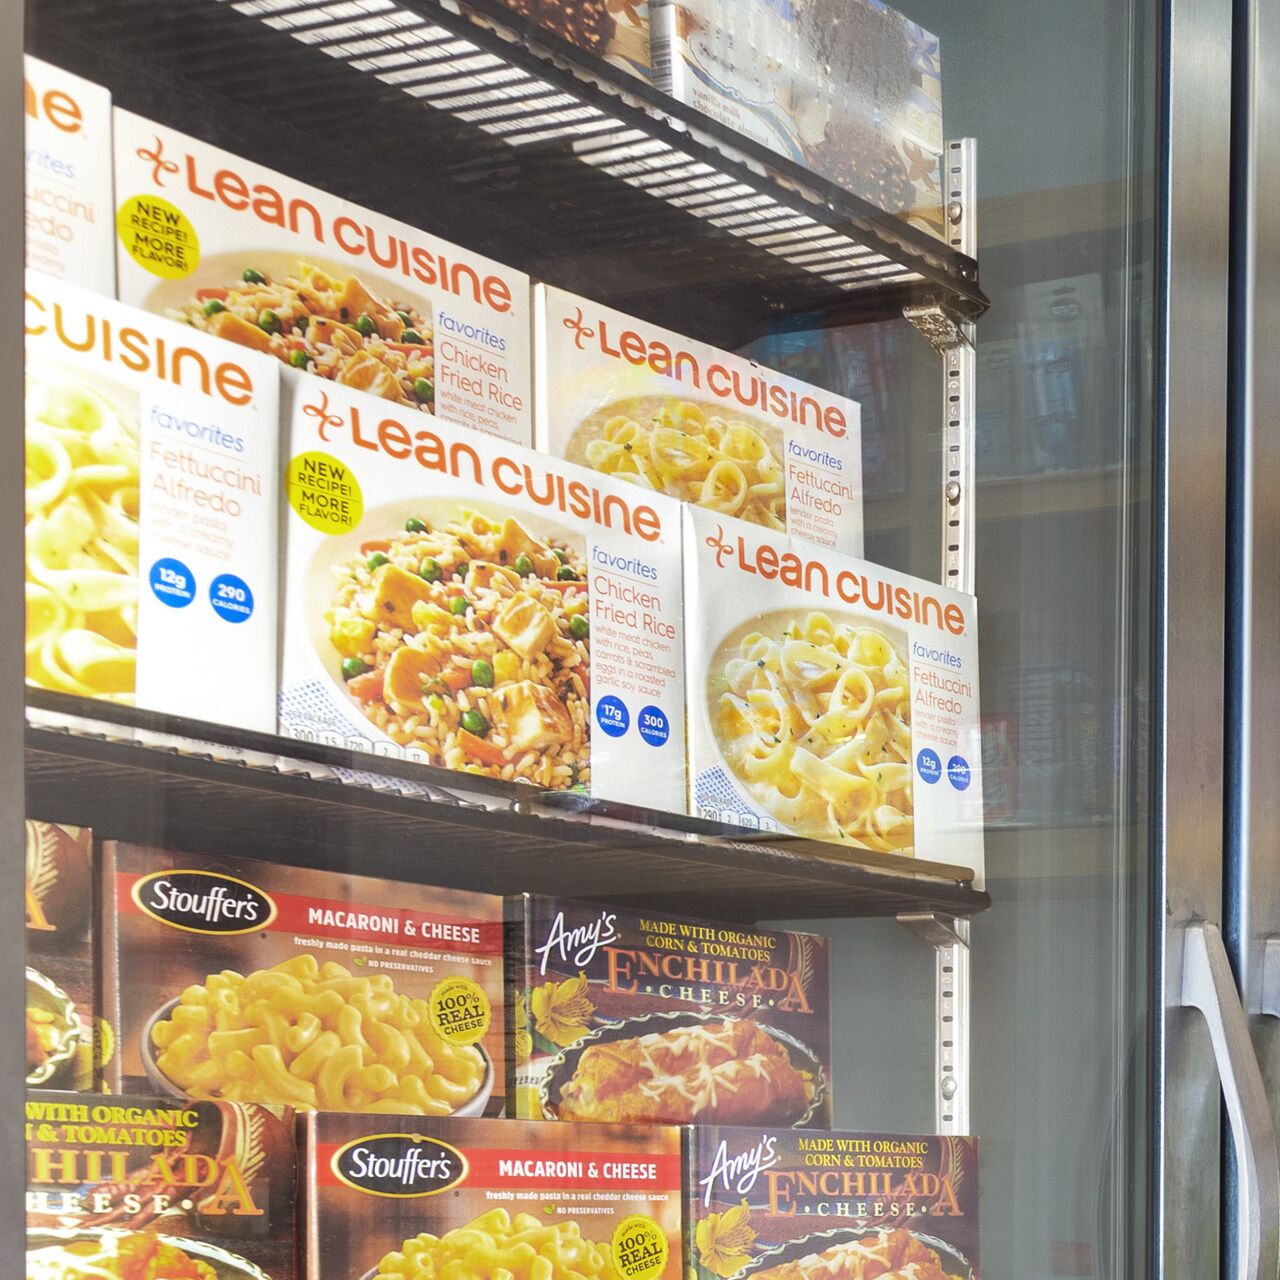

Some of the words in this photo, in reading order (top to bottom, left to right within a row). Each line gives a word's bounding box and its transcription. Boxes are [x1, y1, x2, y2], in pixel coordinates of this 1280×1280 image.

[438, 311, 506, 351] favorites
[440, 341, 508, 383] Chicken
[440, 364, 484, 399] Fried
[488, 381, 523, 411] Rice
[303, 458, 345, 481] NEW
[298, 472, 352, 496] RECIPE!
[299, 502, 352, 526] FLAVOR!
[301, 490, 349, 514] MORE
[592, 546, 657, 580] favorites
[594, 575, 661, 611] Chicken
[595, 599, 637, 628] Fried
[643, 613, 675, 639] Rice
[912, 641, 962, 669] favorites
[913, 666, 972, 698] Fettuccini
[603, 704, 622, 721] 17g
[915, 690, 962, 715] Alfredo
[643, 714, 664, 729] 300
[150, 880, 259, 922] Stouffer's
[308, 907, 399, 934] MACARONI
[404, 920, 416, 936] &
[421, 922, 480, 944] CHEESE
[535, 911, 617, 975] Amy's
[602, 946, 814, 1013] ENCHILADA
[799, 1138, 833, 1152] MADE
[836, 1140, 871, 1153] WITH
[873, 1141, 928, 1154] ORGANIC
[349, 1147, 451, 1184] Stouffer's
[499, 1159, 583, 1178] MACARONI
[587, 1162, 599, 1178] &
[603, 1161, 657, 1179] CHEESE
[700, 1135, 777, 1207] Amy's
[805, 1154, 841, 1167] CORN
[844, 1155, 855, 1167] &
[859, 1156, 922, 1169] TOMATOES
[763, 1170, 964, 1217] ENCHILADA
[817, 1202, 915, 1217] CHEESE
[619, 1231, 657, 1251] 100%
[621, 1245, 663, 1269] REAL
[626, 1256, 662, 1277] CHEESE
